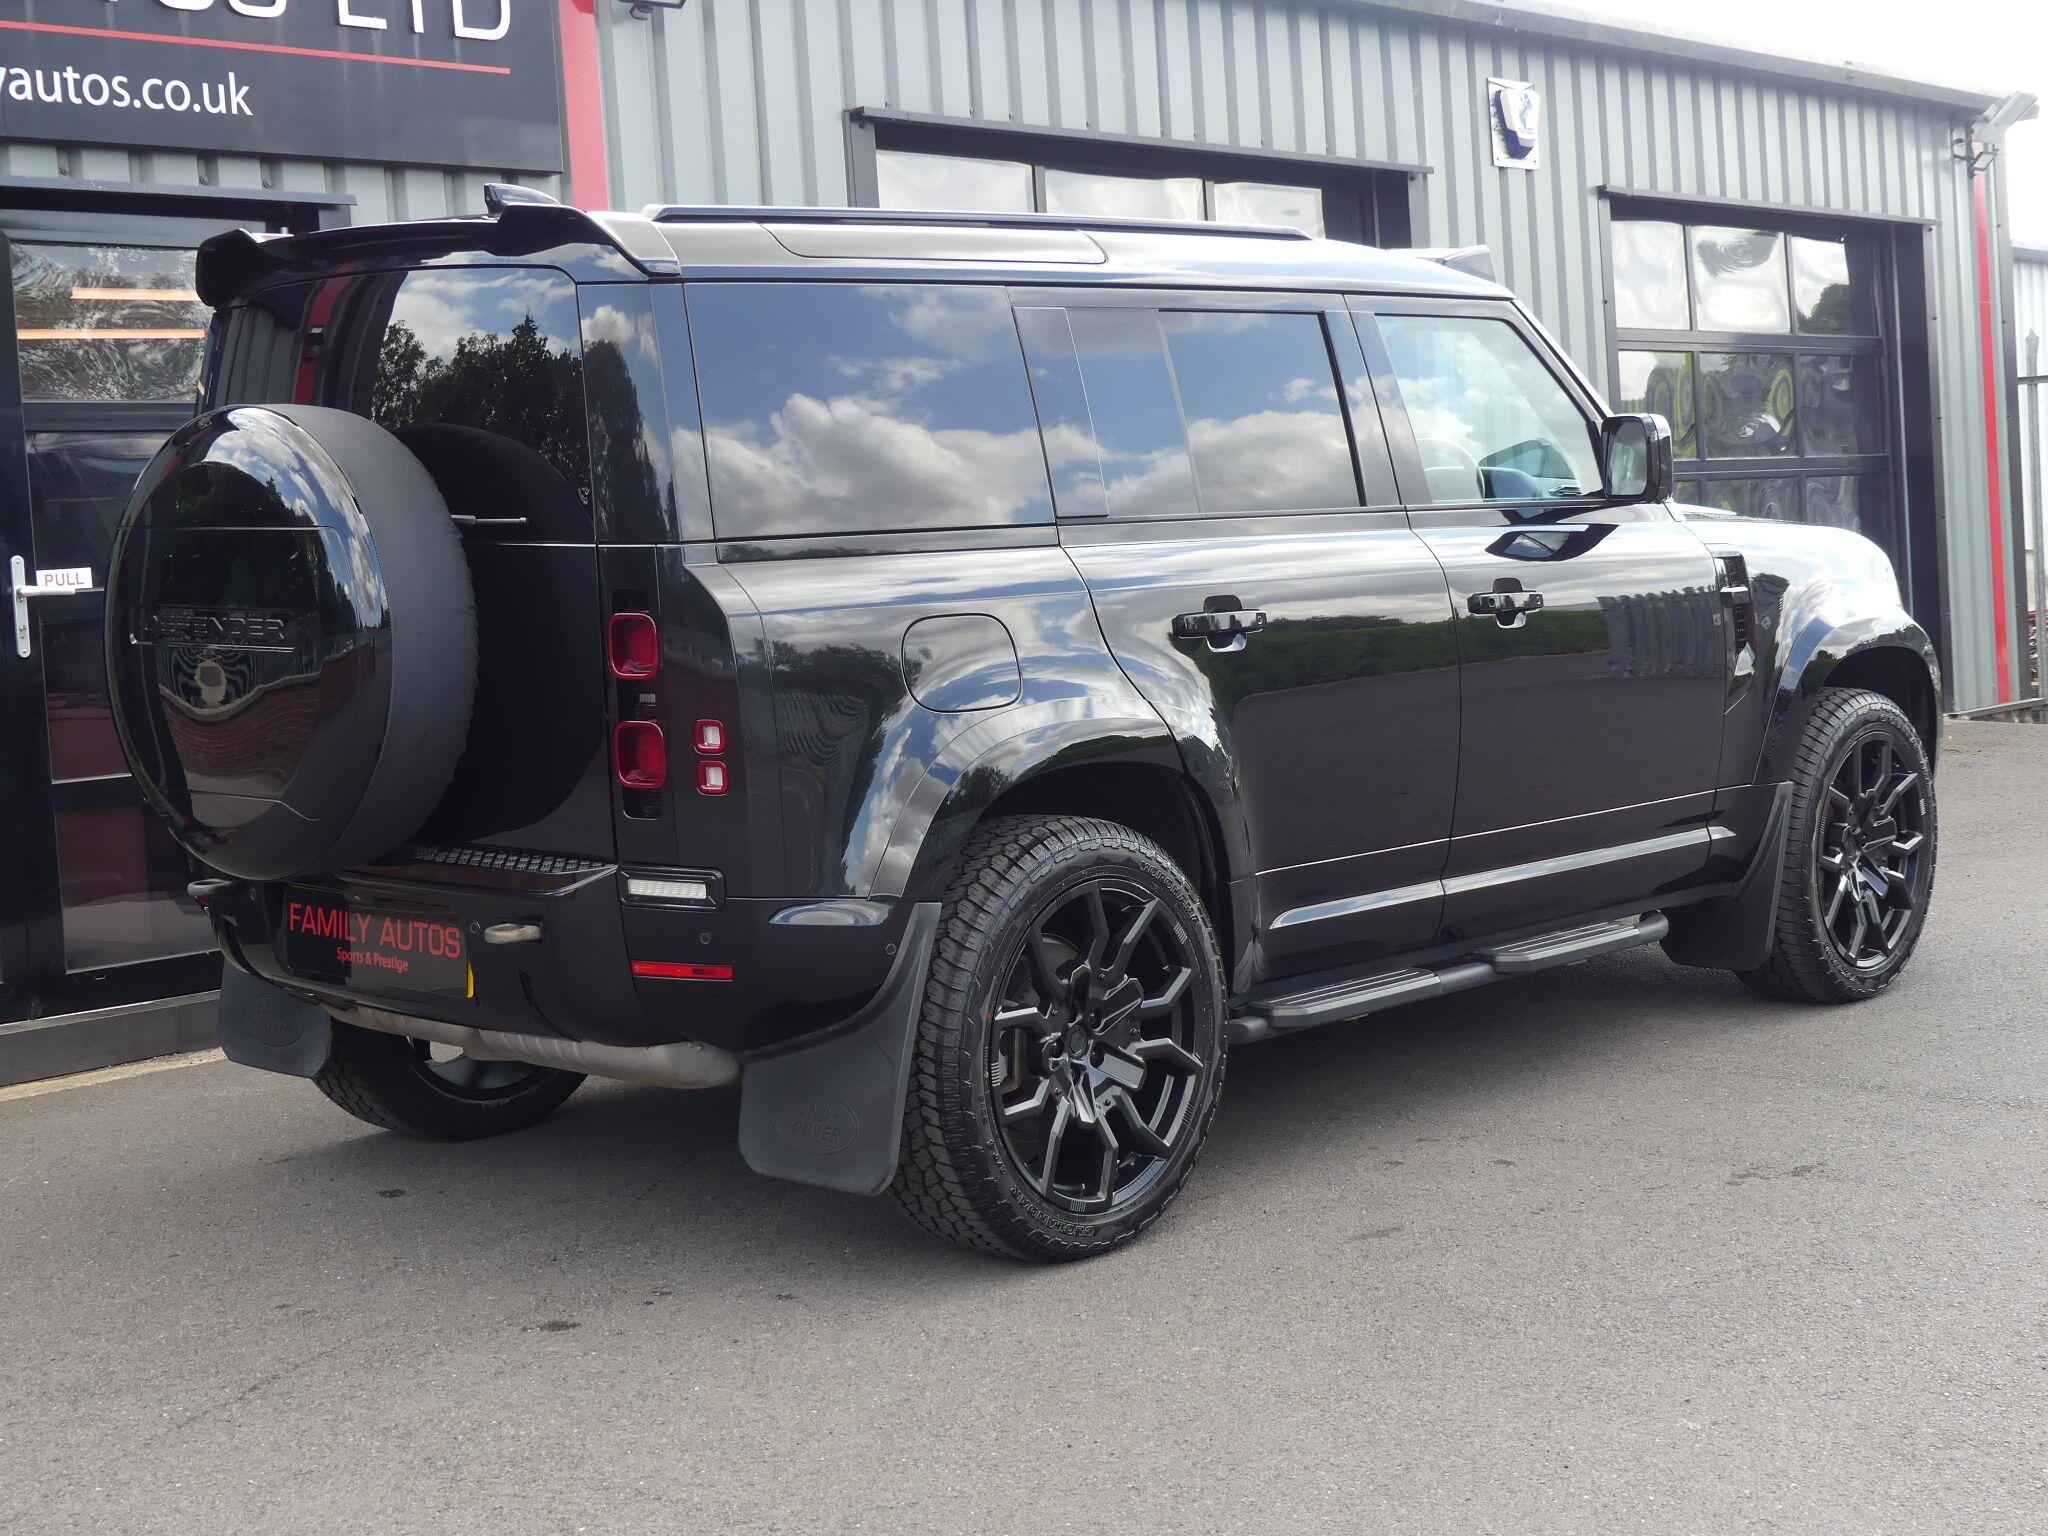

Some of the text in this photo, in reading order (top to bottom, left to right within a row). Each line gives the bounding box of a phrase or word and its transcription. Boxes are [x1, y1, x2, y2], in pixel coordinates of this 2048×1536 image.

[44, 572, 85, 587] PULL
[289, 902, 462, 959] FAMILY AUTOS
[336, 946, 364, 965] Sports
[373, 951, 409, 973] Prestige
